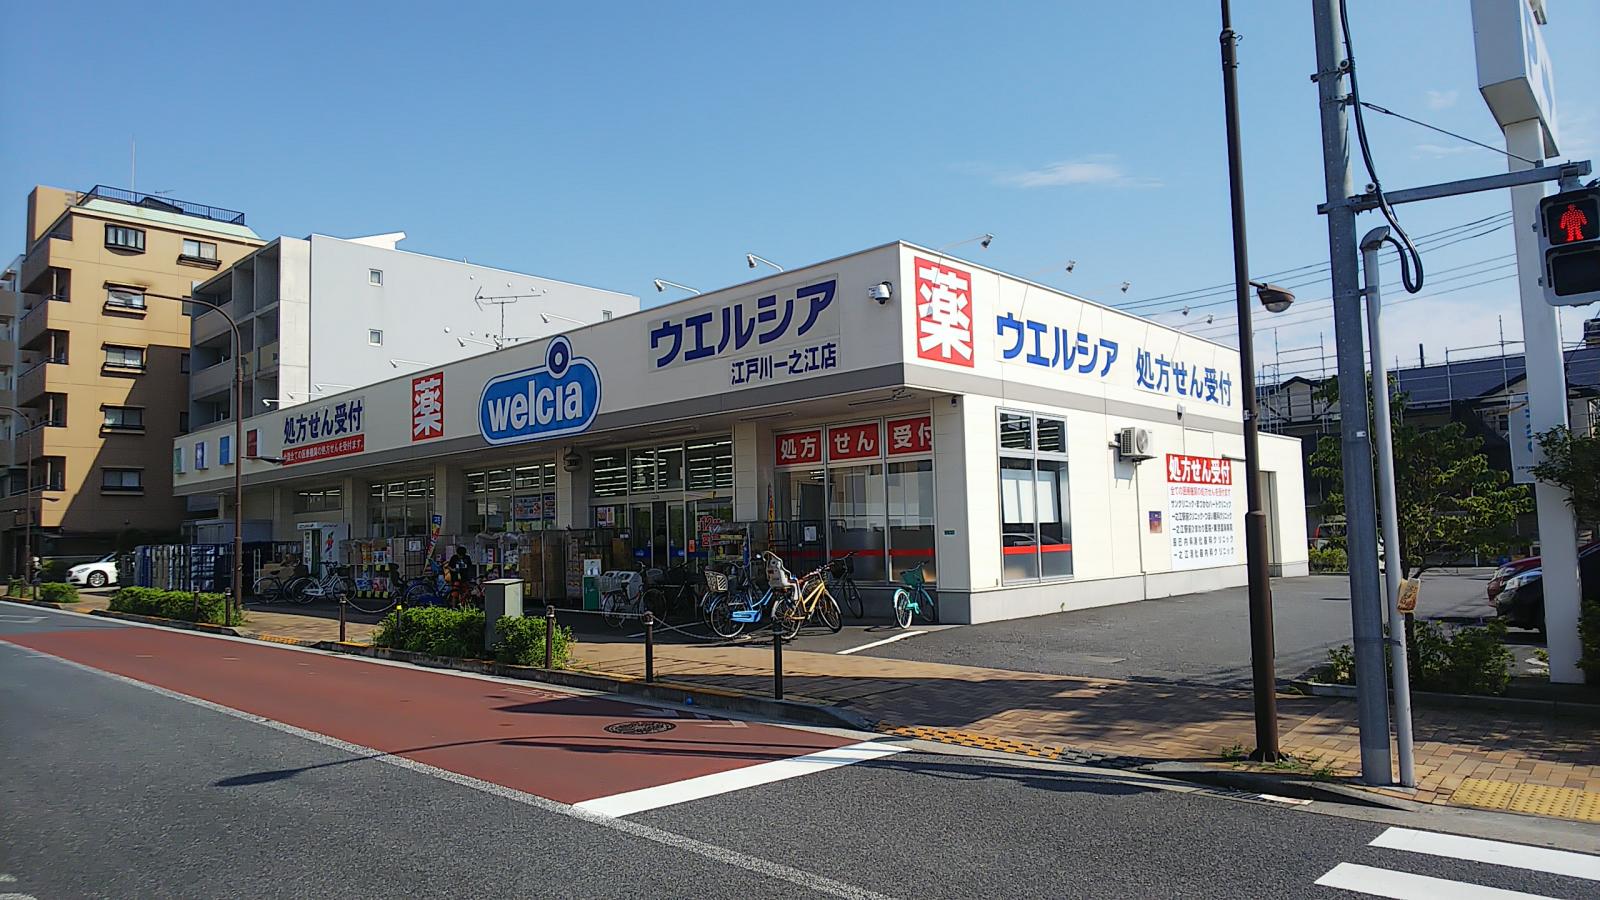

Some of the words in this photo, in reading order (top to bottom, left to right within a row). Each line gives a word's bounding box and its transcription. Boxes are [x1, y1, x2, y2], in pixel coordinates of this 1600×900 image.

[650, 279, 837, 368] ウエルシア
[918, 264, 973, 363] 薬
[731, 342, 837, 385] 江戸川一之江店
[996, 311, 1119, 378] ウエルシア
[1135, 347, 1232, 407] 処方せん受付
[284, 400, 363, 444] 処方せん受付
[413, 377, 442, 437] 薬
[487, 379, 583, 433] welcia
[781, 436, 817, 460] 処方
[834, 430, 874, 454] せん
[1169, 455, 1231, 485] 処方せん受付
